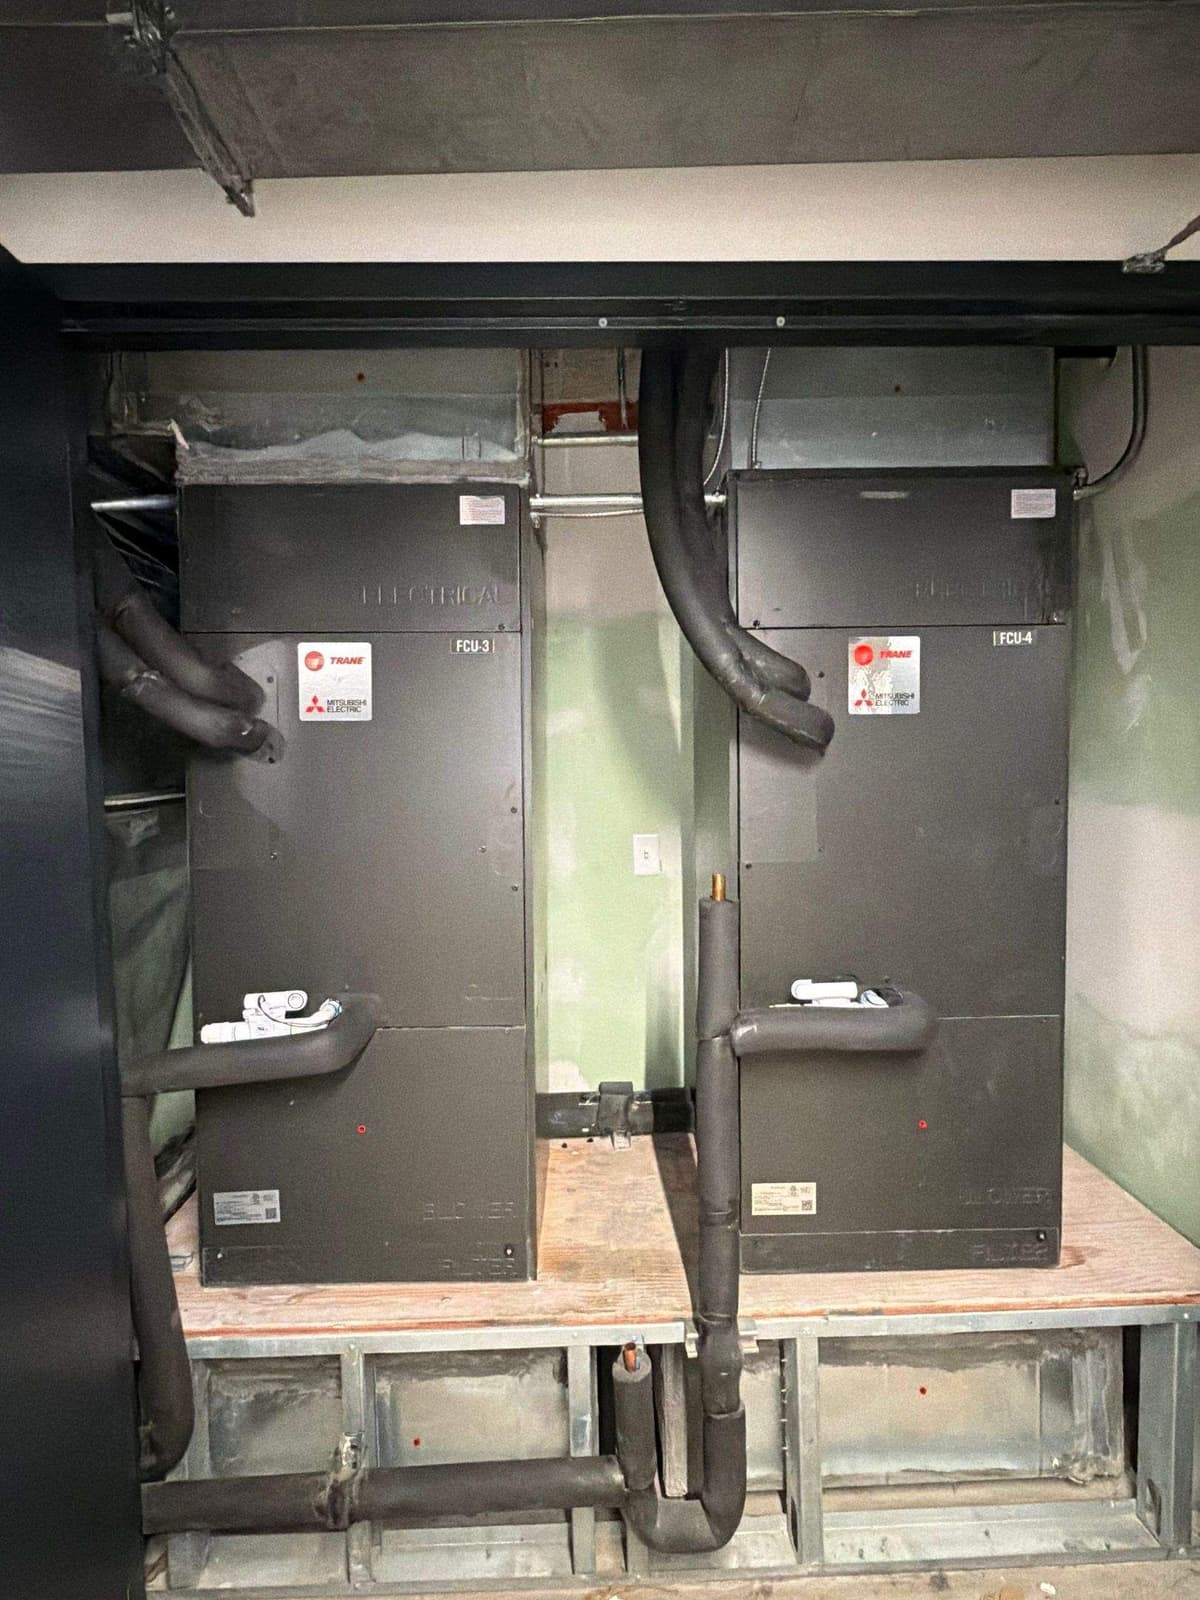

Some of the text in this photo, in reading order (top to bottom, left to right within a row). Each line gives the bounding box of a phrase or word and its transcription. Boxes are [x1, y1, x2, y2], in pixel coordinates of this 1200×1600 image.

[999, 631, 1033, 645] FCU-4
[456, 639, 490, 653] FCU-3
[879, 650, 912, 659] TRANE
[329, 656, 365, 665] TRANE
[875, 692, 915, 700] MITSUBISHI
[326, 699, 367, 707] MITSUBISHI
[875, 699, 909, 707] ELECTRIC
